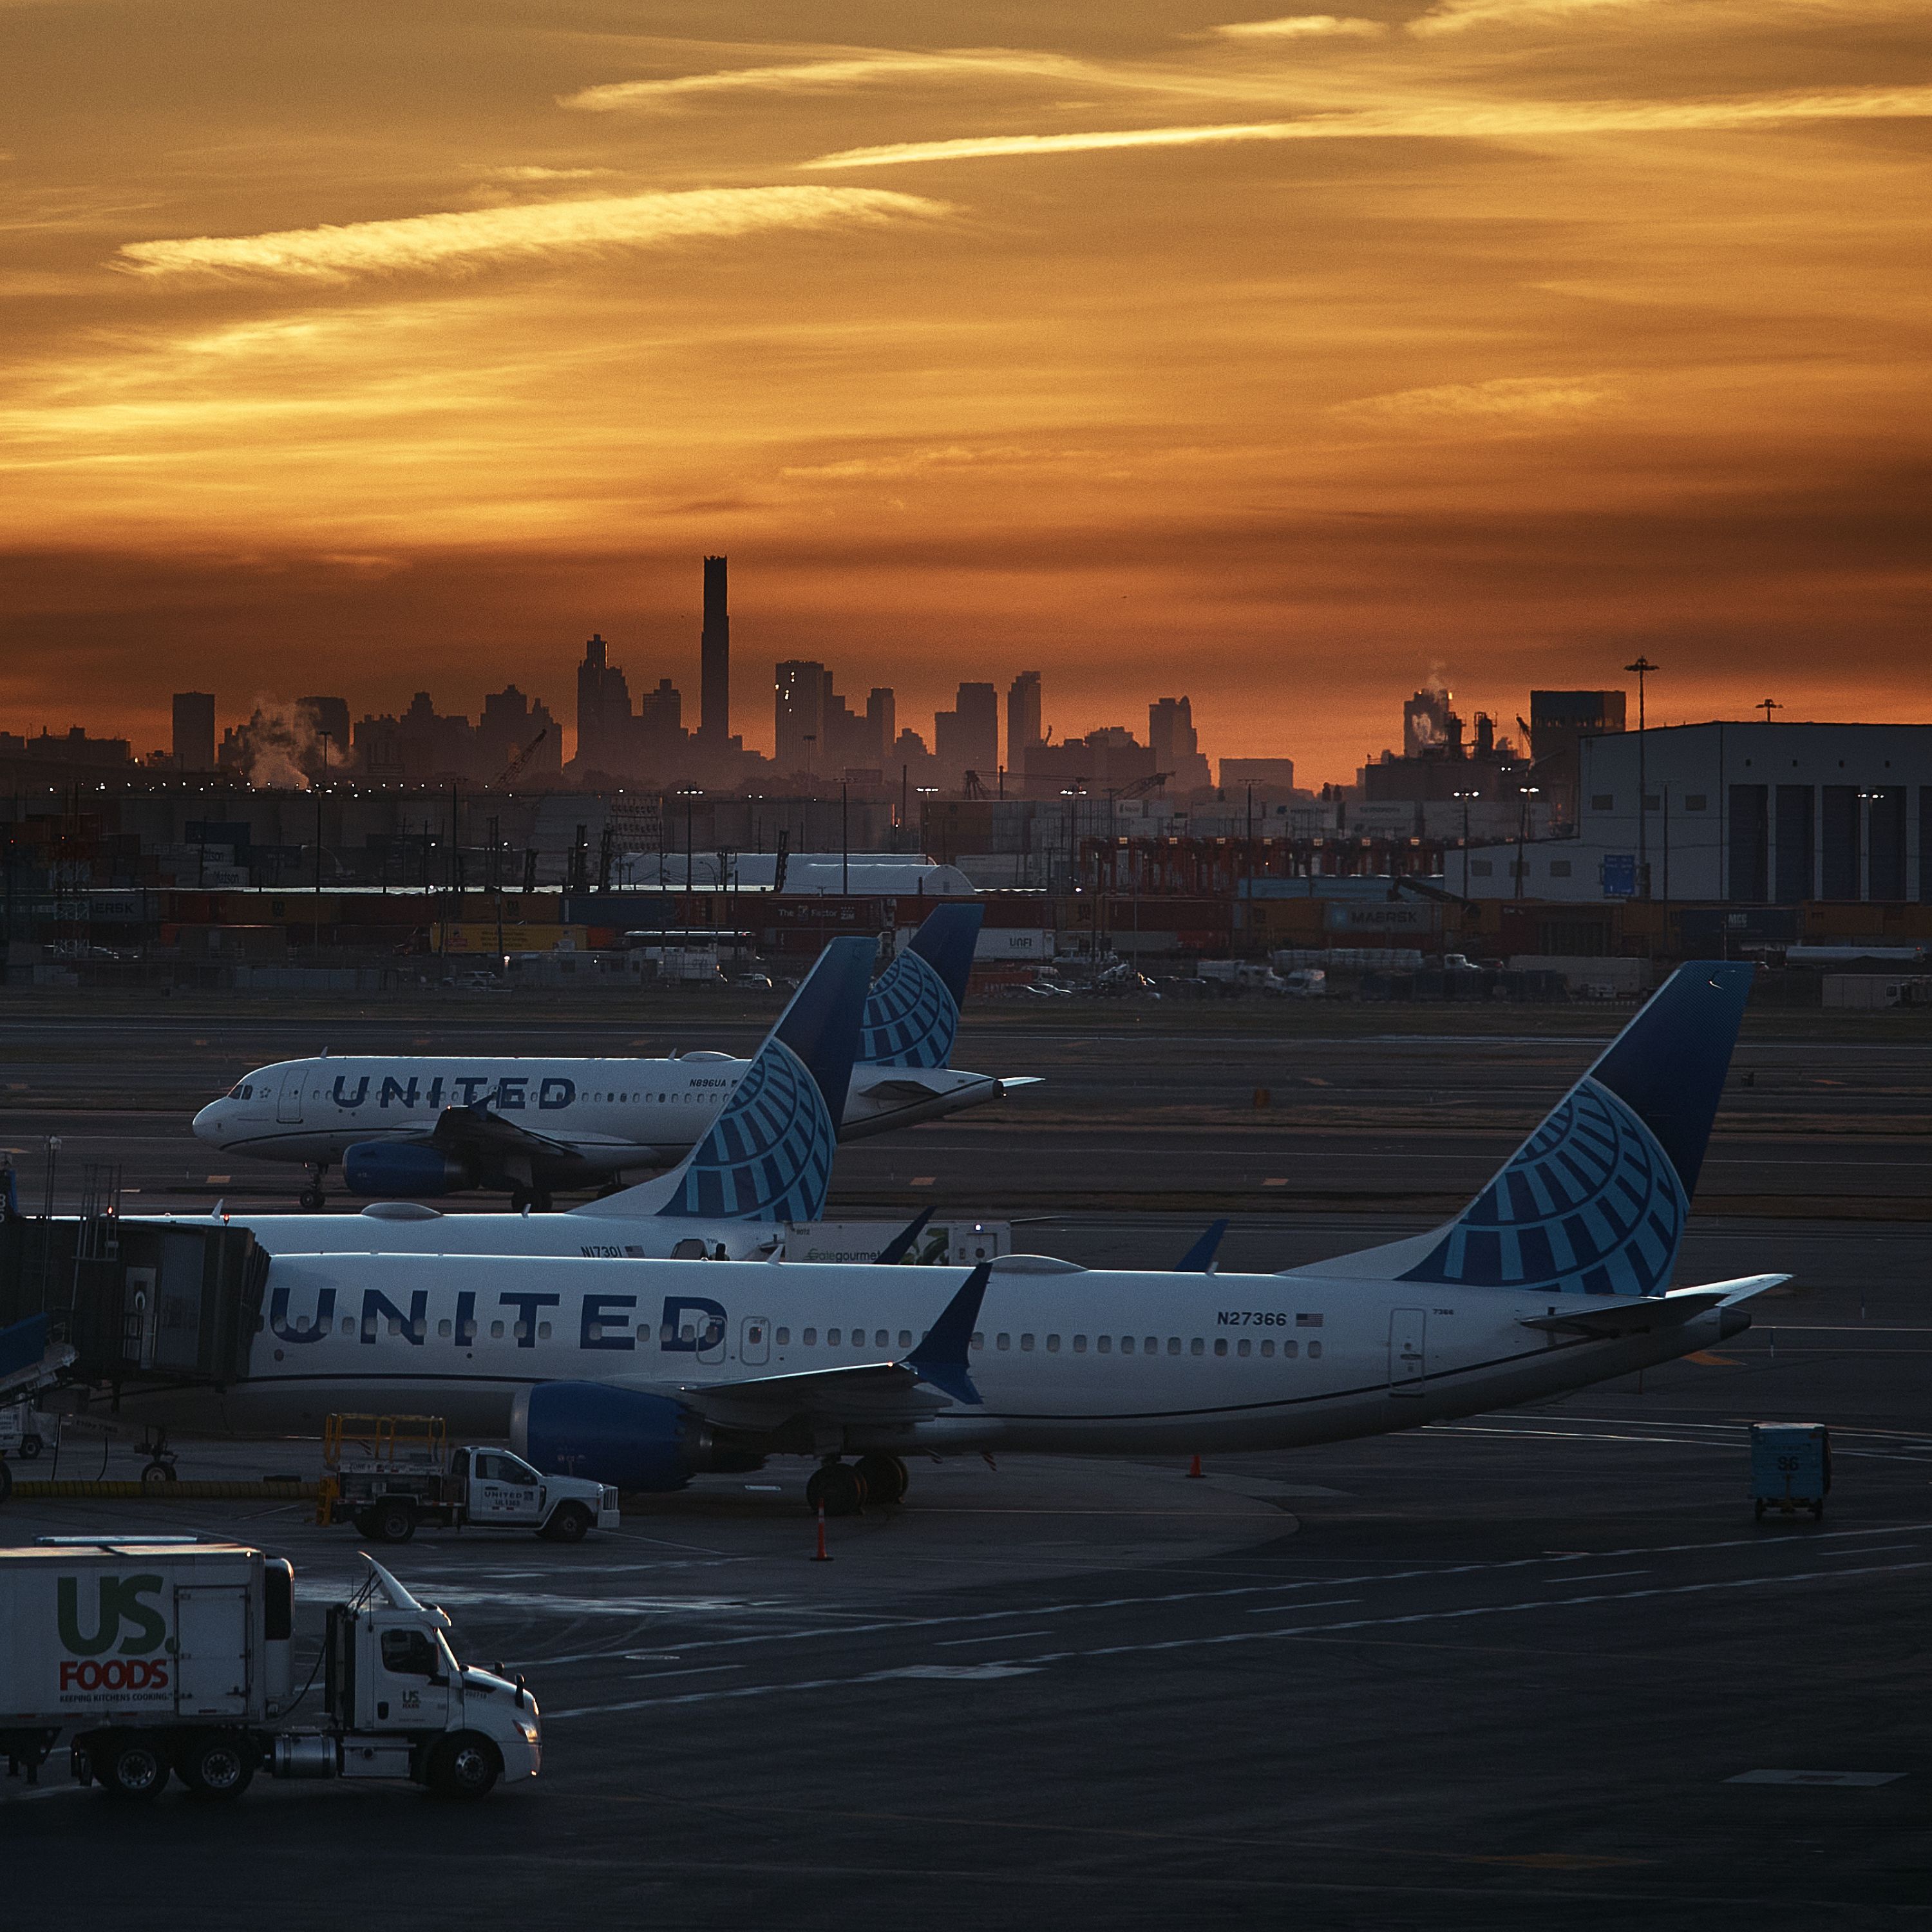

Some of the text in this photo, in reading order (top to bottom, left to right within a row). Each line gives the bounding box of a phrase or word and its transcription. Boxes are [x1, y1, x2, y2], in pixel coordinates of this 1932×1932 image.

[778, 909, 794, 917] The
[1352, 911, 1417, 923] MAERSK
[690, 1079, 726, 1087] N896UA
[334, 1075, 575, 1109] UNITED
[270, 1287, 728, 1352] UNITED
[1217, 1311, 1287, 1327] N27366
[60, 1659, 169, 1691] FOODS
[60, 1694, 91, 1703] KEEPING
[93, 1693, 131, 1702] KITCHENS
